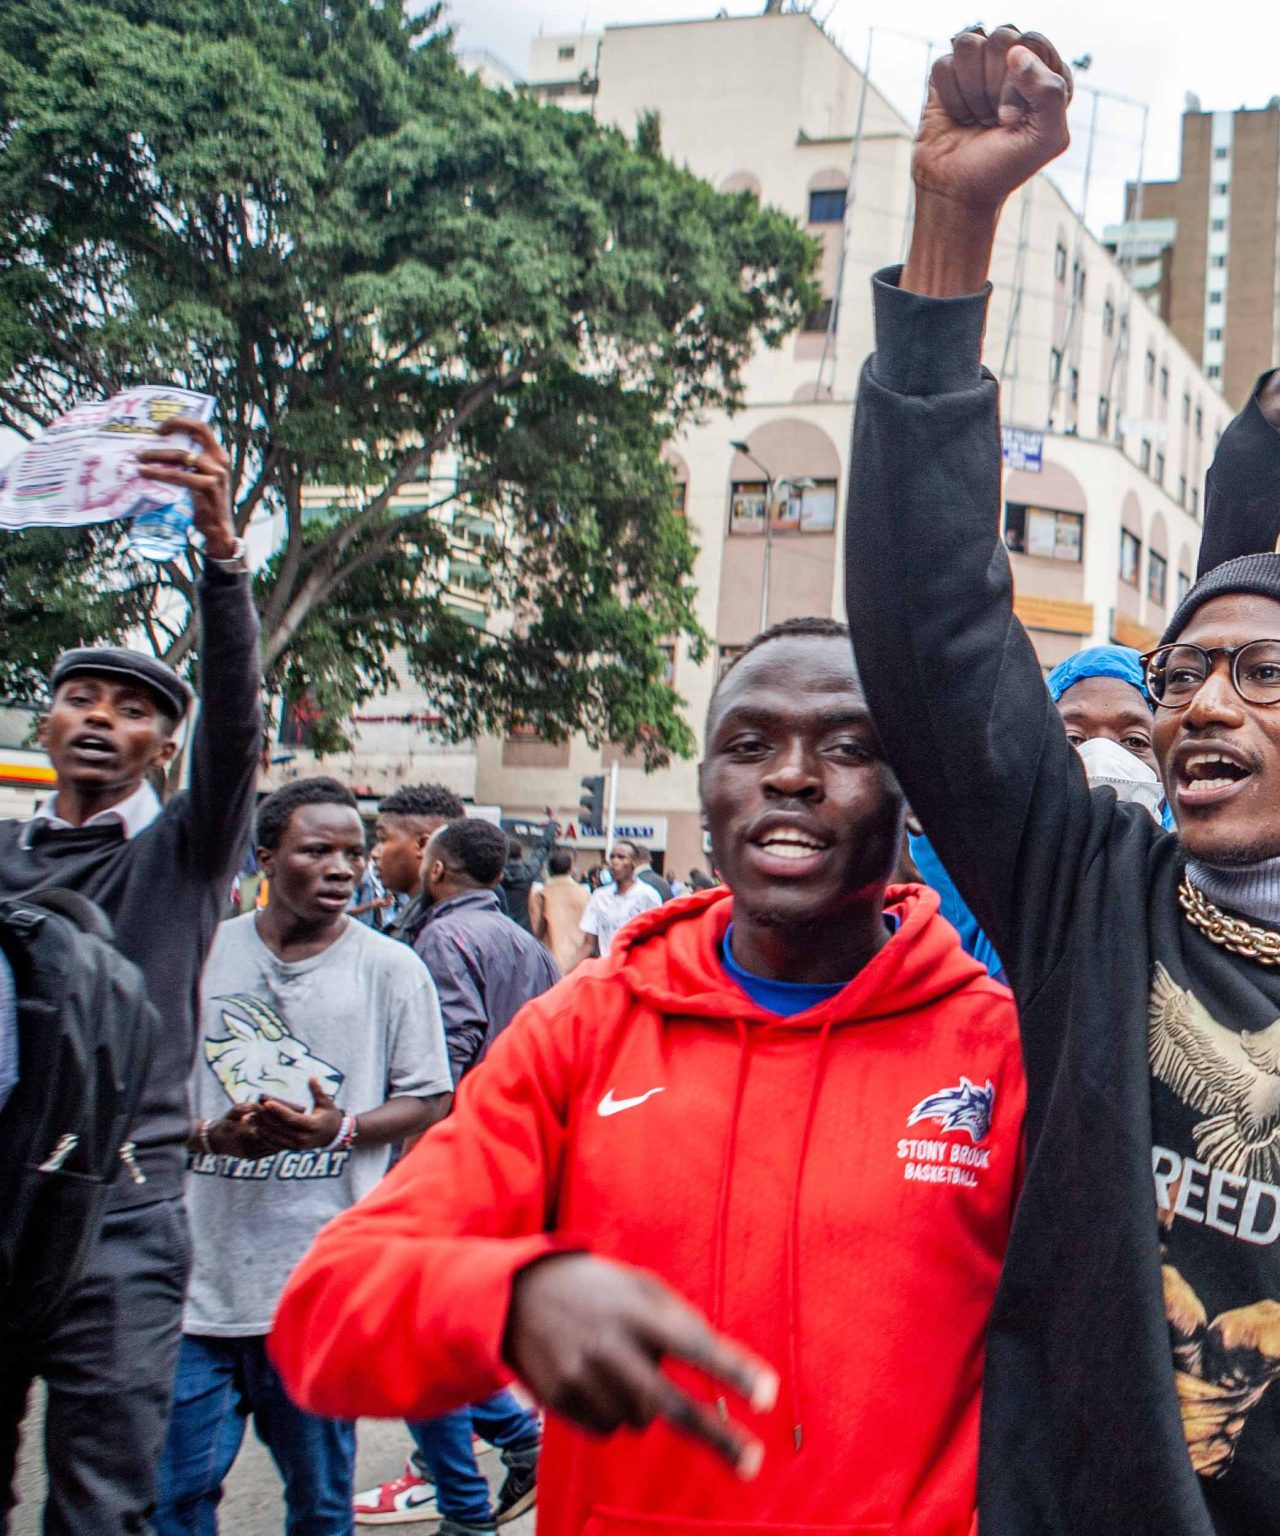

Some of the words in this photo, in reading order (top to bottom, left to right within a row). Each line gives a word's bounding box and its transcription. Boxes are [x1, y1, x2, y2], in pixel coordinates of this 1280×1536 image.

[220, 1154, 275, 1180] THE
[277, 1150, 350, 1181] GOAT
[897, 1138, 948, 1162] STONY
[949, 1143, 992, 1170] BROOK
[904, 1161, 979, 1188] BASKETBALL
